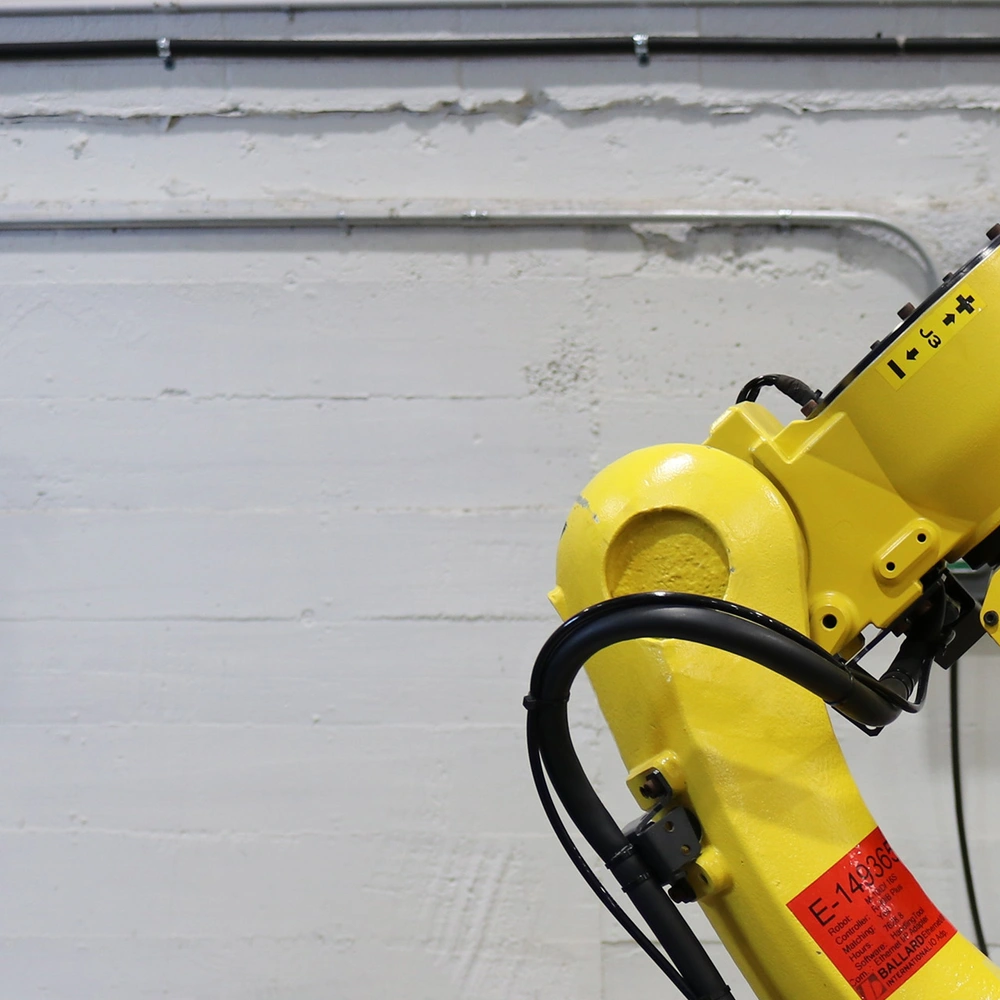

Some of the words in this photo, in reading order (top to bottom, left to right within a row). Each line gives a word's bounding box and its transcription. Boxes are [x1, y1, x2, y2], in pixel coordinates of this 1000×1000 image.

[919, 328, 942, 349] J3
[808, 840, 900, 927] E-149365
[828, 915, 852, 936] Robot:
[835, 914, 870, 945] Controller:
[842, 925, 876, 954] Matching:
[873, 939, 902, 966] Ethernet
[877, 933, 926, 980] BALLARD
[886, 947, 933, 987] INTERNATIONAL
